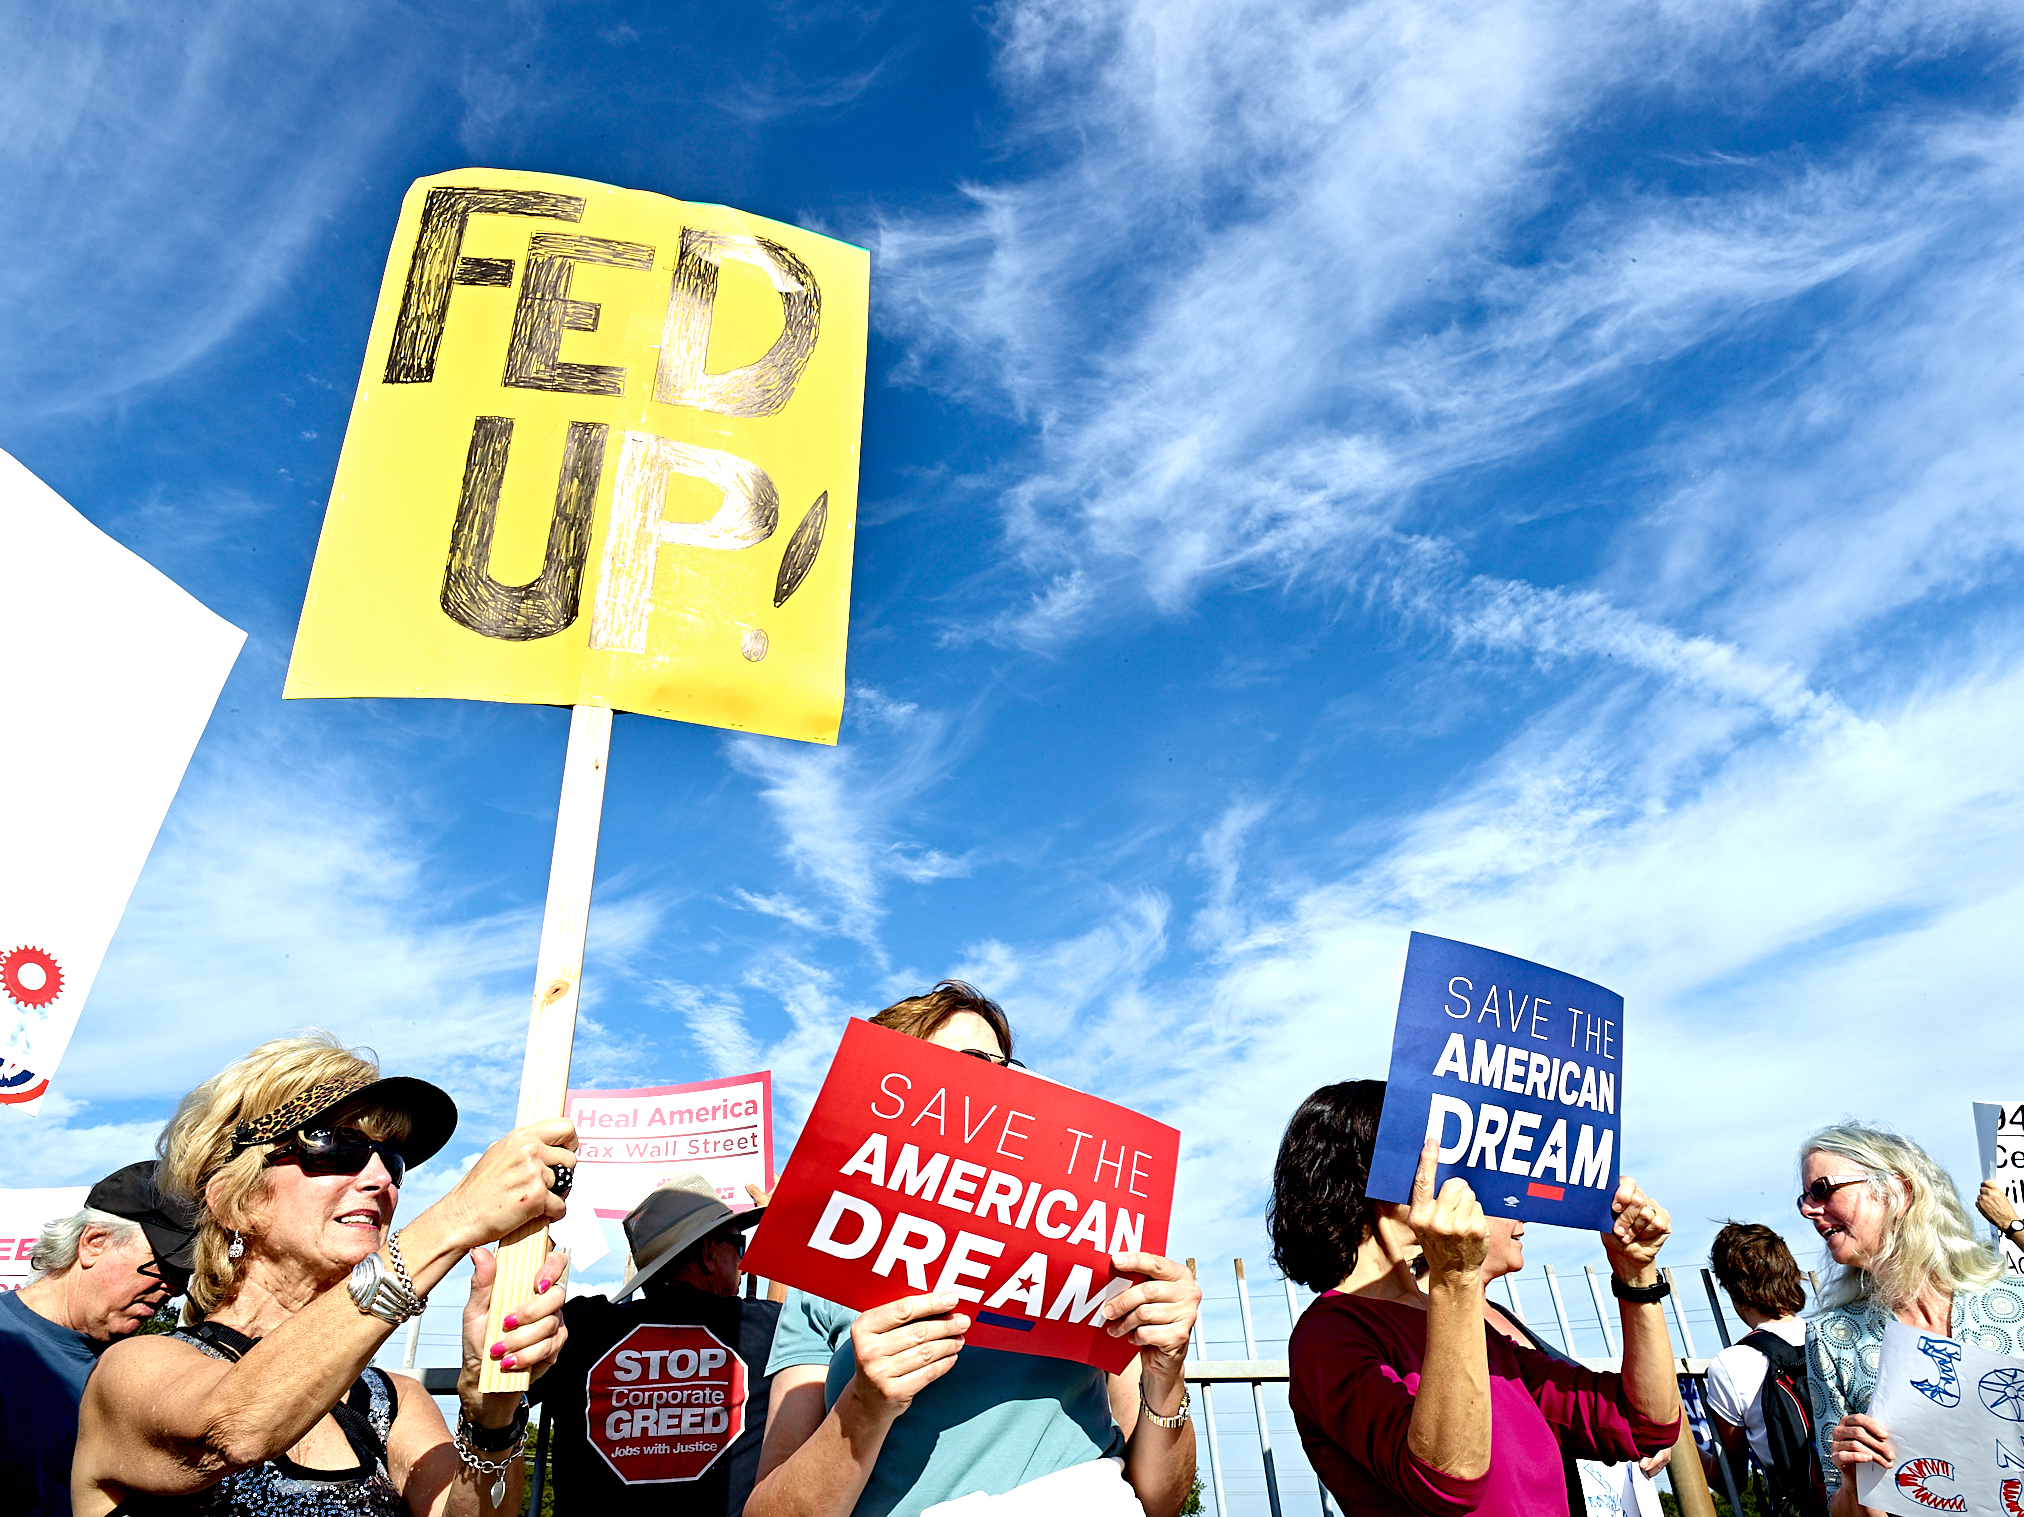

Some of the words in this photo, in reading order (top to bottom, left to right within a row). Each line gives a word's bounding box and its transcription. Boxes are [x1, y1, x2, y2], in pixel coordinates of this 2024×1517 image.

[382, 186, 822, 418] FED
[440, 415, 829, 662] UP!
[1445, 976, 1551, 1041] SAVE
[1568, 1007, 1615, 1060] THE
[576, 1108, 638, 1129] Heal
[647, 1098, 758, 1127] America
[1432, 1032, 1615, 1115] AMERICAN
[577, 1142, 614, 1158] Tax
[626, 1140, 677, 1158] Wall
[688, 1132, 758, 1155] Street
[871, 1073, 1036, 1161] SAVE
[1066, 1127, 1153, 1198] THE
[1424, 1092, 1615, 1191] DREAM
[839, 1132, 1146, 1257] AMERICAN
[807, 1189, 1133, 1328] DREAM
[611, 1387, 725, 1410] Corporate
[614, 1348, 727, 1382] STOP
[605, 1406, 729, 1441] GREED
[611, 1446, 640, 1459] Jobs
[643, 1442, 670, 1455] with
[673, 1441, 718, 1455] Justice
